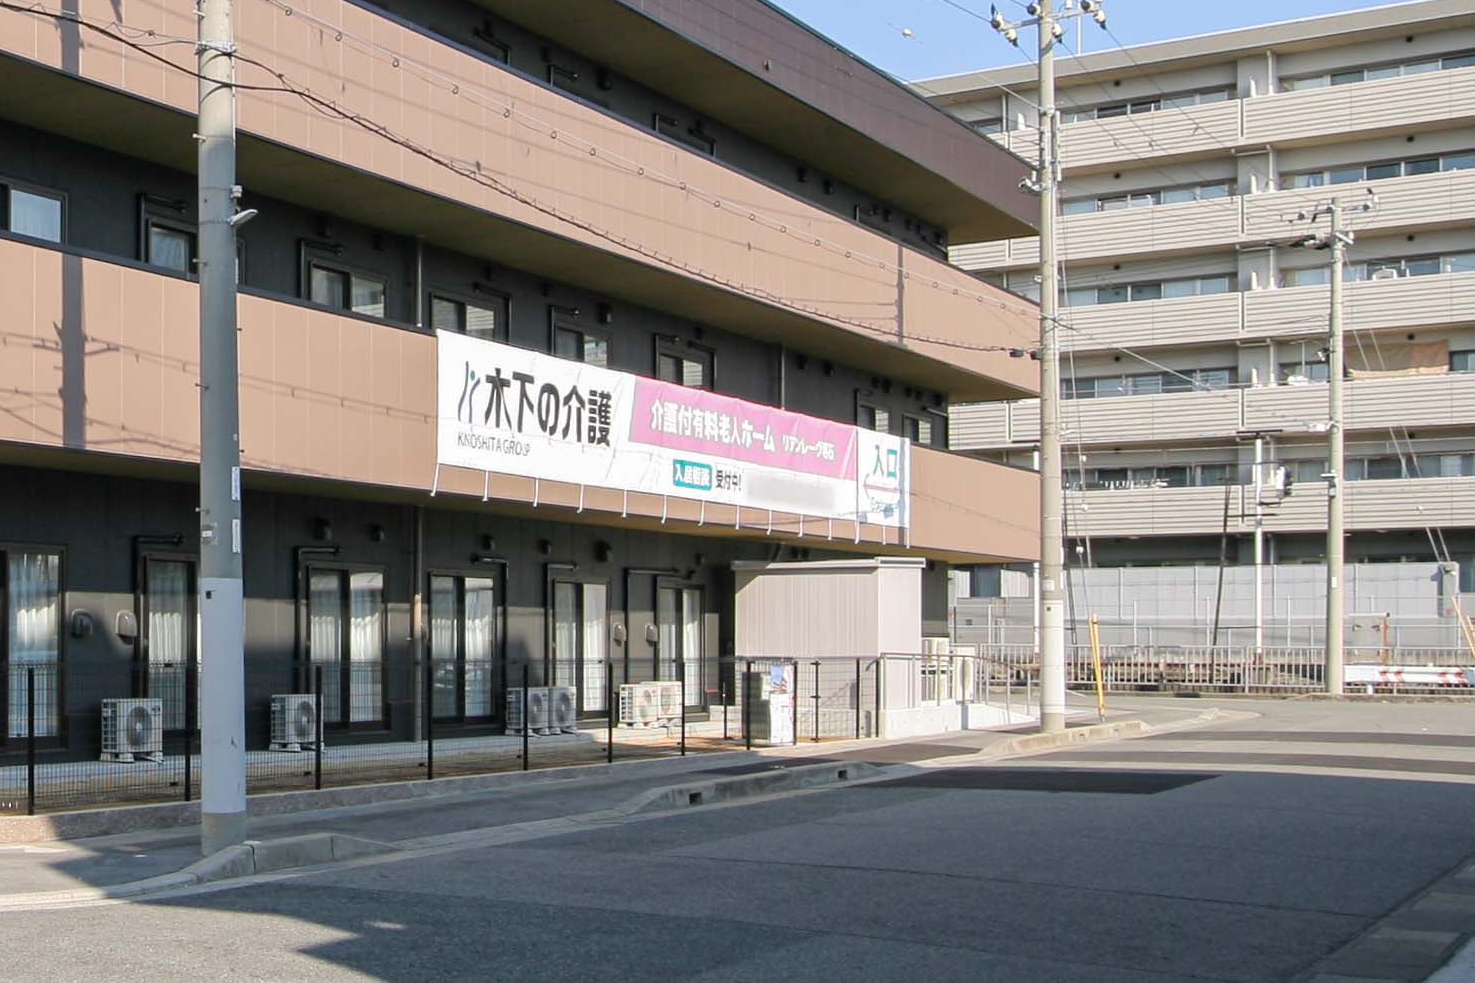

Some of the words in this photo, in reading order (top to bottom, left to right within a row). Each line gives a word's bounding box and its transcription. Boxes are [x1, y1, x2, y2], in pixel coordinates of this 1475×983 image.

[484, 368, 612, 447] 木下の介護
[651, 399, 776, 452] 介護付有料老人ホーム
[873, 444, 898, 479] 入口
